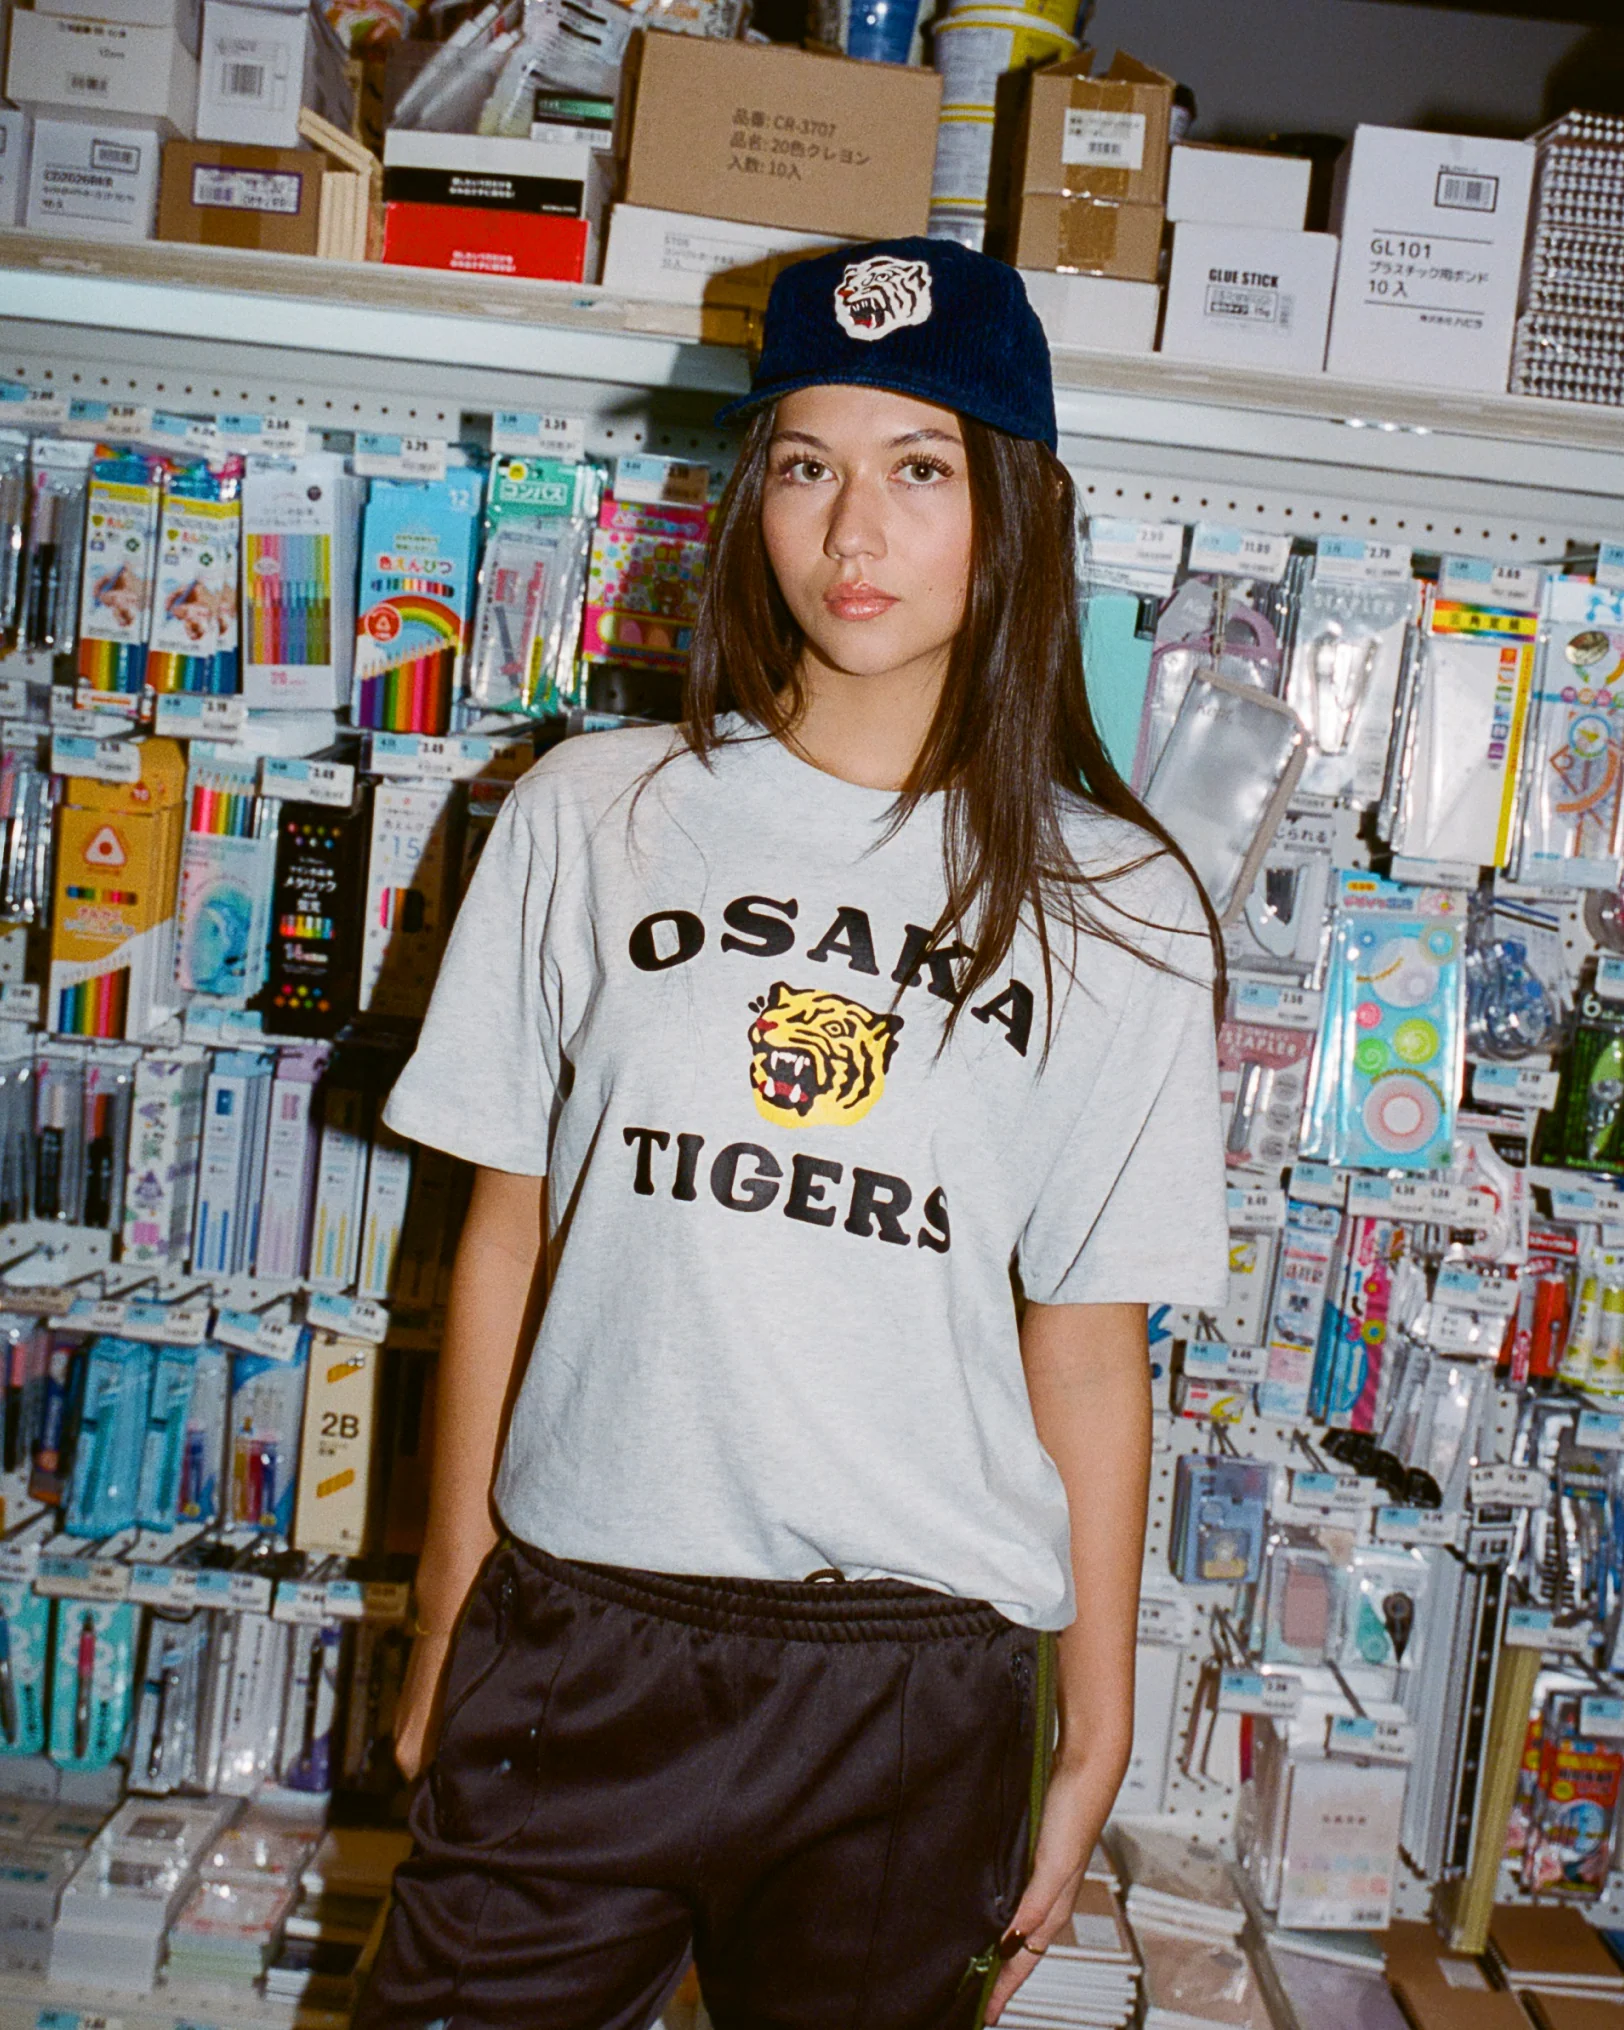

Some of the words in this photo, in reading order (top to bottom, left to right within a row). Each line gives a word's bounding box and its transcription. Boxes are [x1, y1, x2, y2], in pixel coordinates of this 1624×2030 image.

[1370, 237, 1432, 260] GL101
[1208, 267, 1238, 284] GLUE
[1242, 271, 1279, 289] STICK
[502, 482, 565, 501] コンパス
[628, 894, 1034, 1057] OSAKA
[622, 1126, 951, 1254] TIGERS
[320, 1409, 360, 1439] 2B
